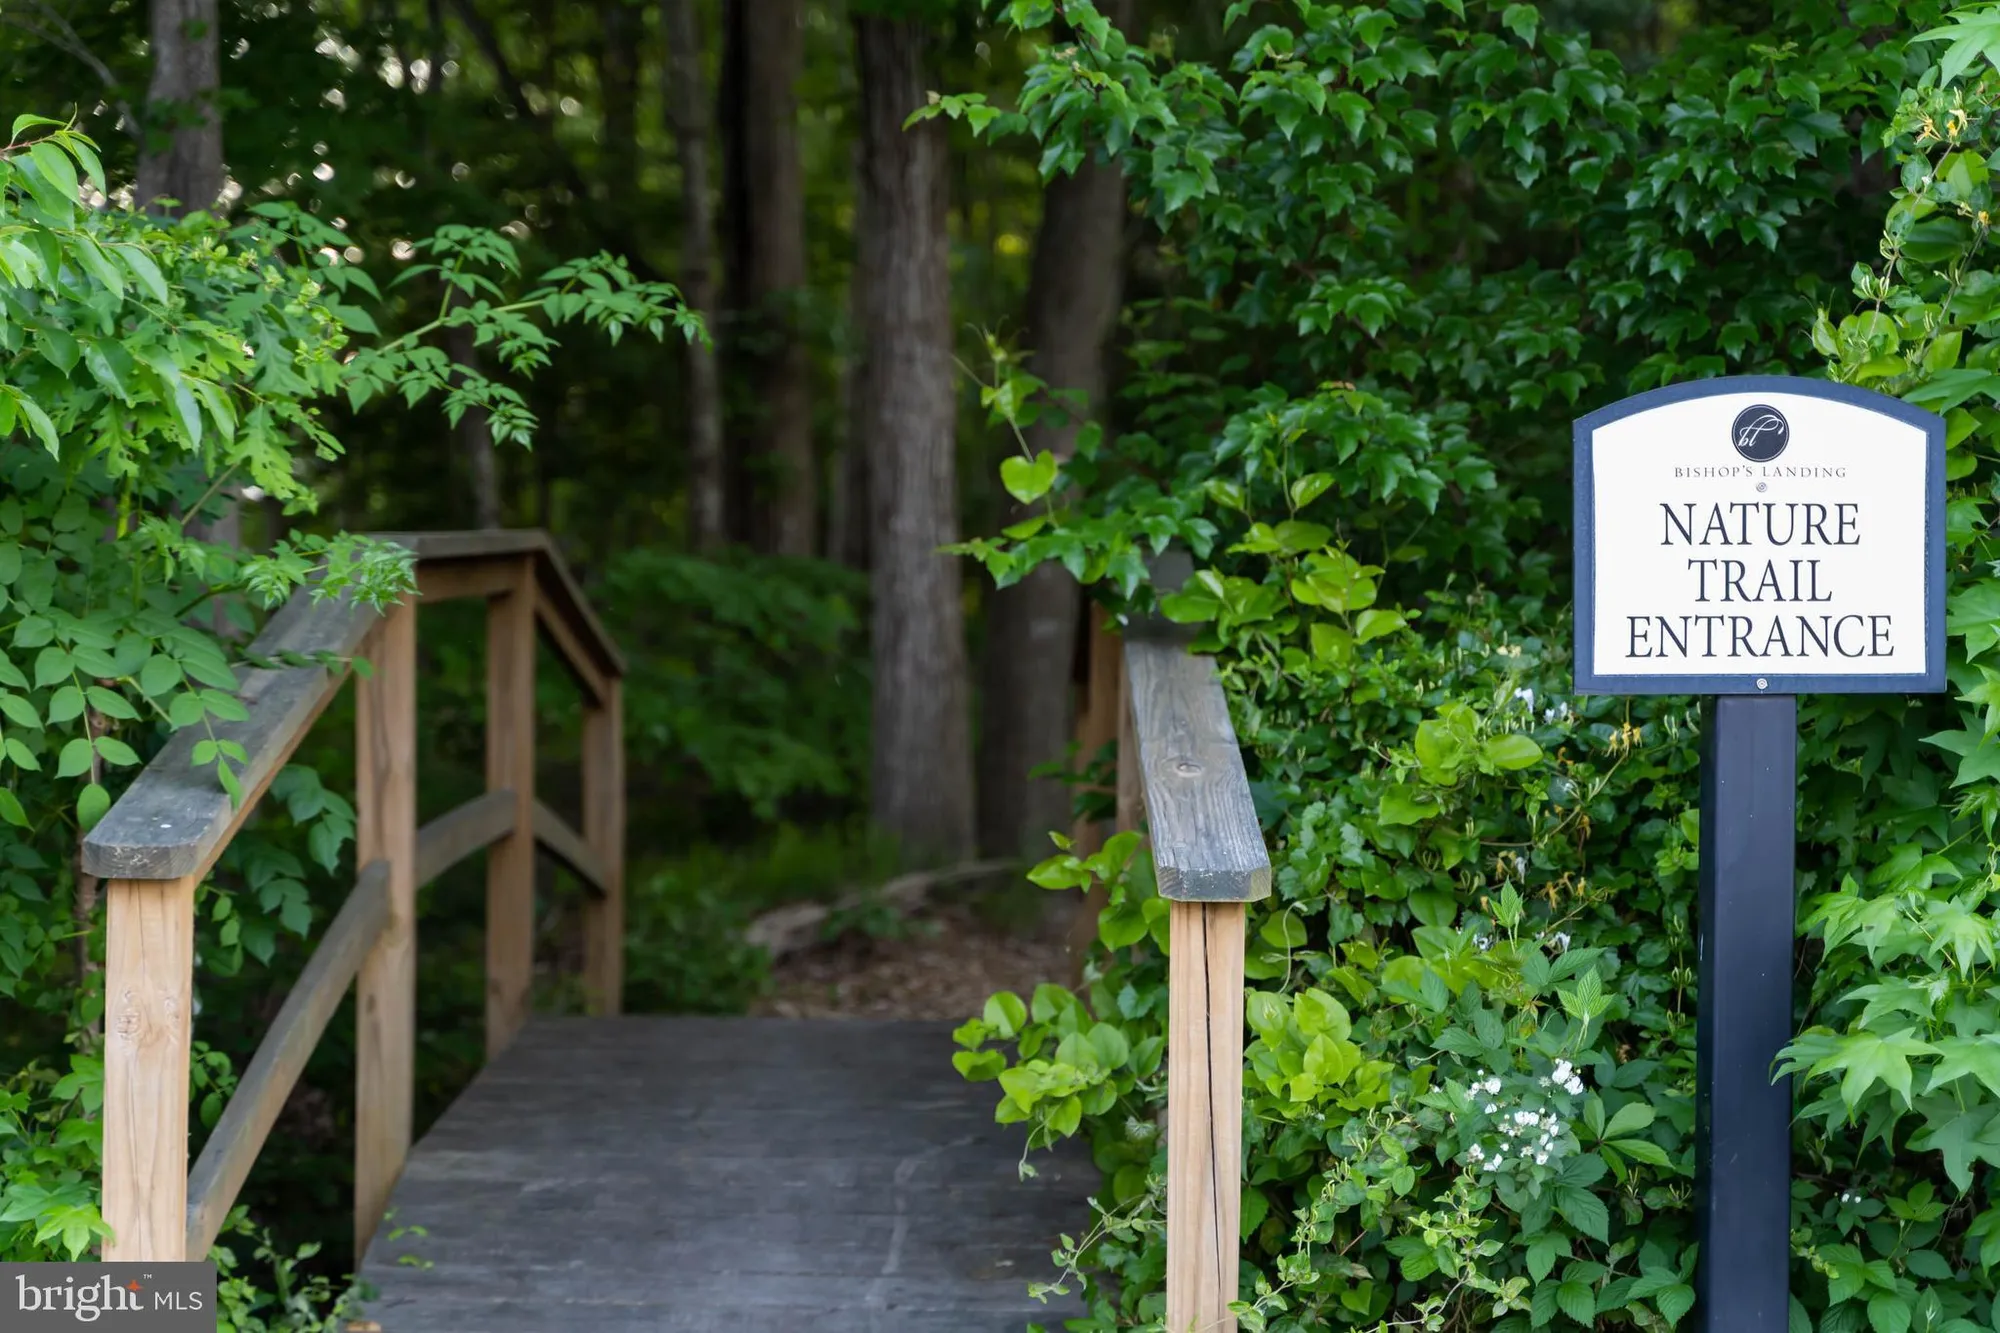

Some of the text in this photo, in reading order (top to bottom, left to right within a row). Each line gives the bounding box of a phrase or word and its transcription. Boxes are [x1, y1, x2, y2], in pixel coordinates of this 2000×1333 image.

[1674, 465, 1847, 478] BISHOP'S LANDING
[1659, 501, 1861, 546] NATURE
[1687, 558, 1833, 603] TRAIL
[1625, 614, 1895, 658] ENTRANCE
